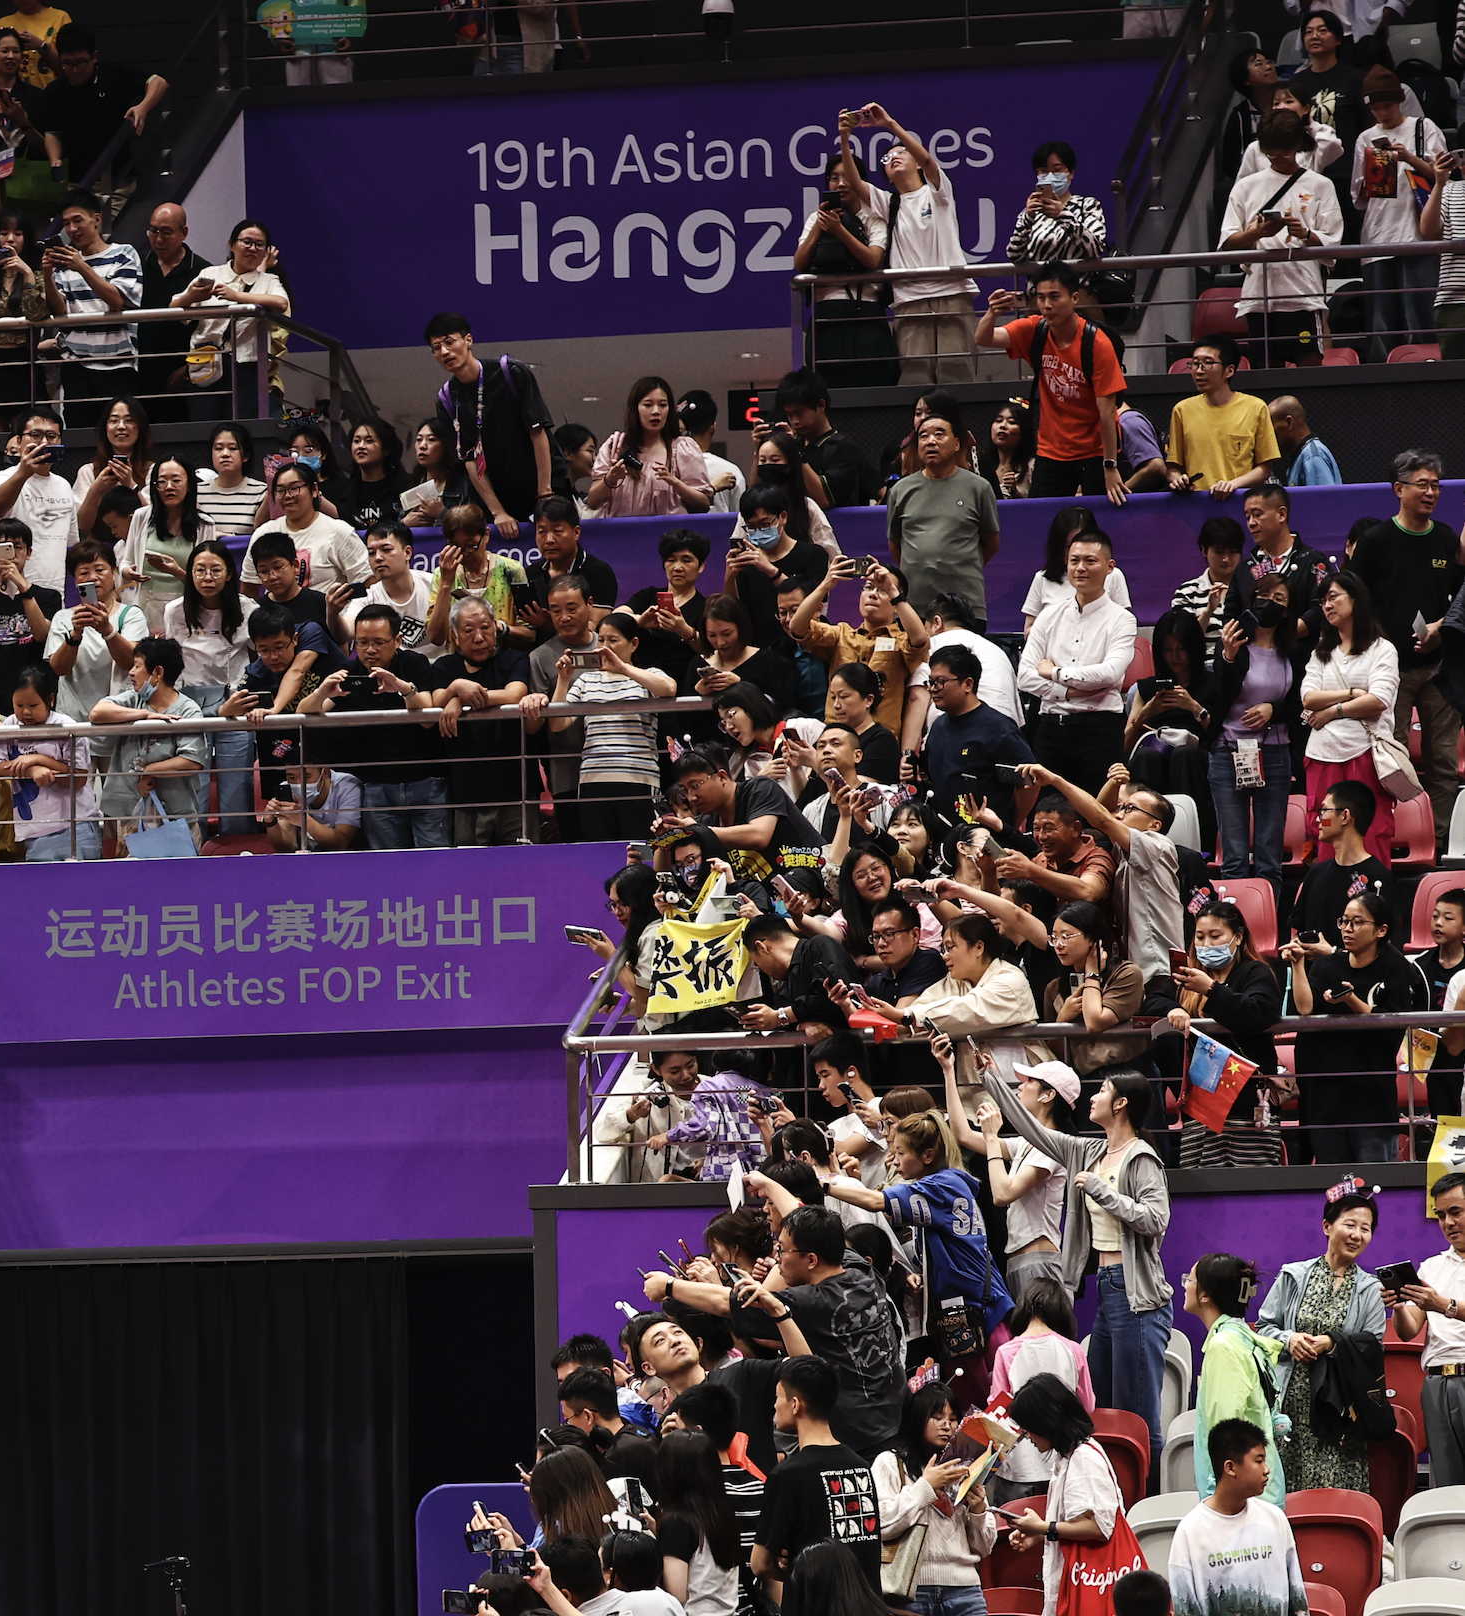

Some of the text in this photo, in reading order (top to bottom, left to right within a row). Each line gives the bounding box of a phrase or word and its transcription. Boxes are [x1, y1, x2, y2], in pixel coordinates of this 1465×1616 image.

[466, 137, 595, 190] 19th
[610, 130, 773, 185] Asian
[1431, 559, 1447, 567] EA7
[45, 894, 536, 959] 运动员比赛场地出口
[113, 961, 472, 1009] Athletes FOP Exit
[907, 1363, 940, 1393] 好球!
[1208, 1545, 1273, 1568] GROWING UP
